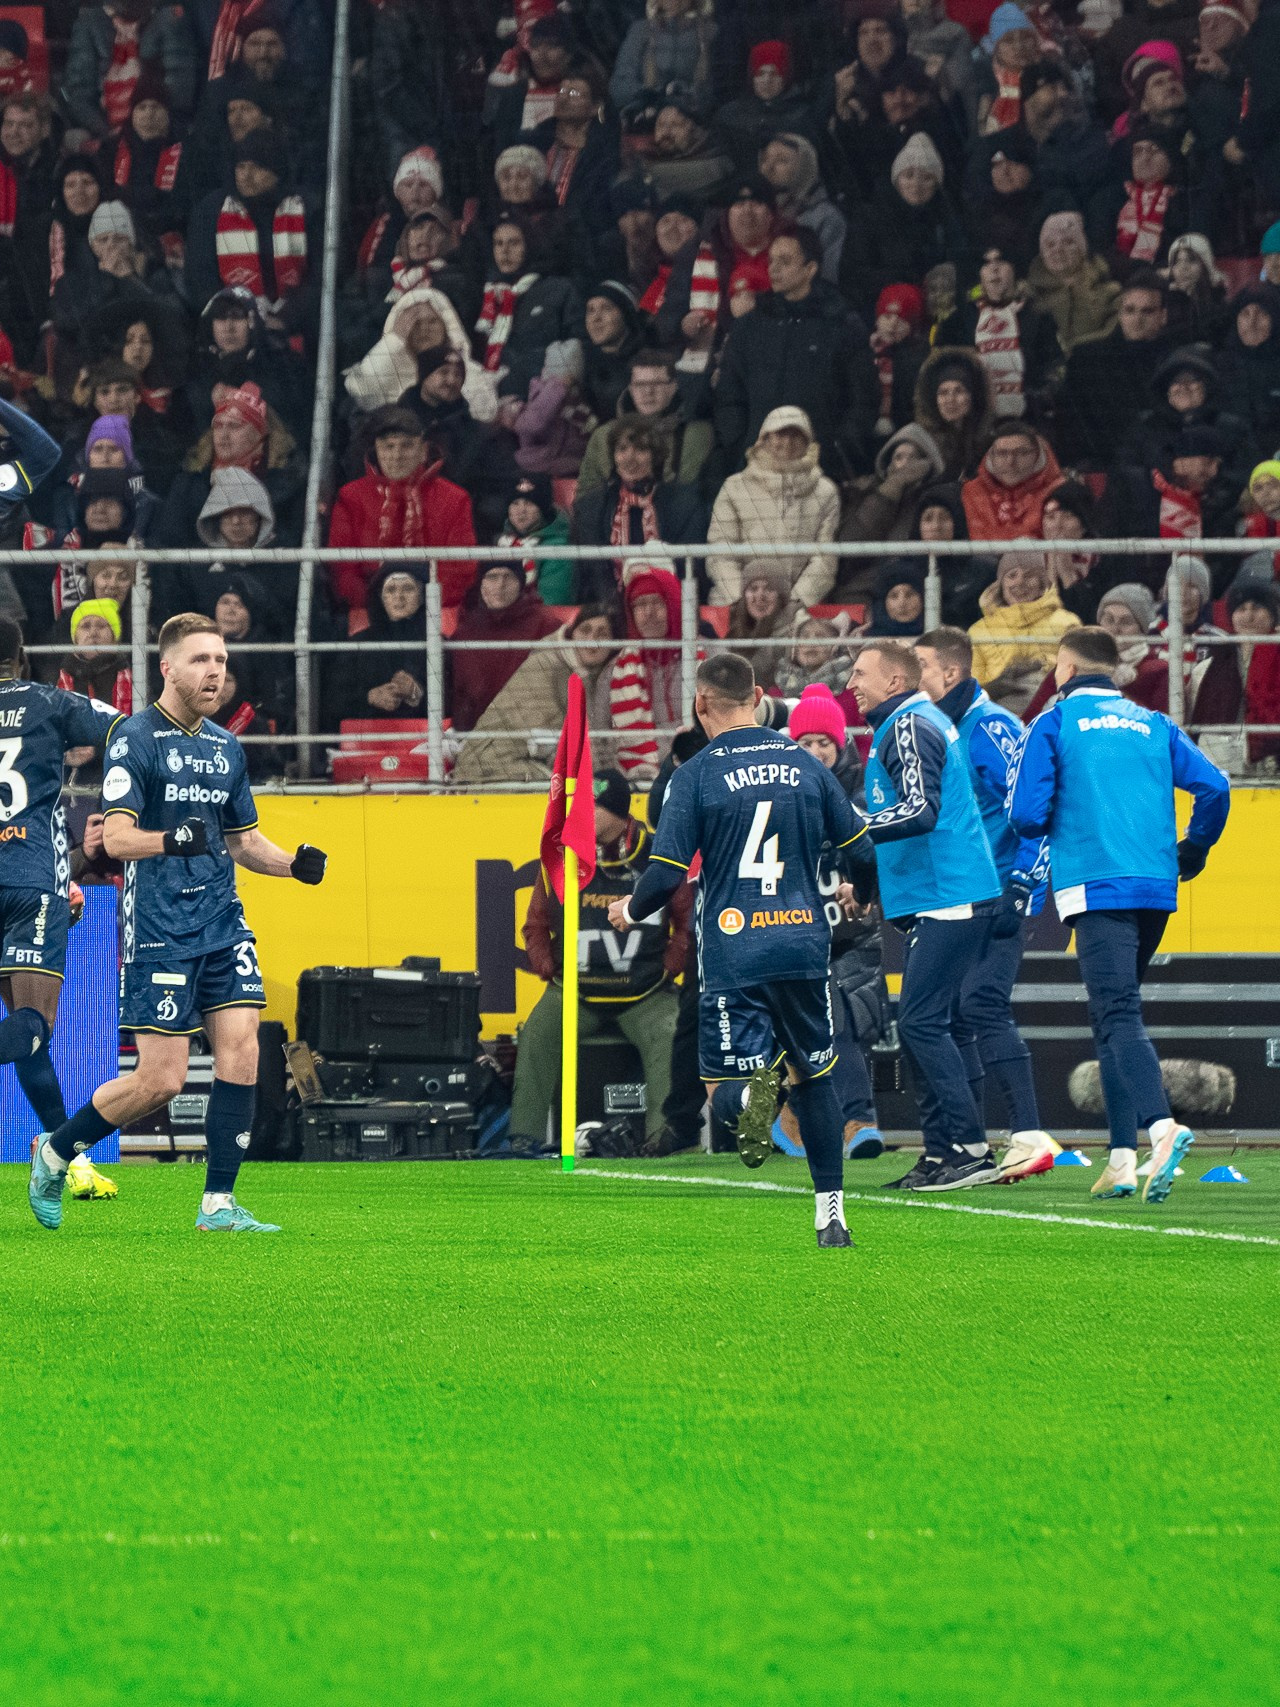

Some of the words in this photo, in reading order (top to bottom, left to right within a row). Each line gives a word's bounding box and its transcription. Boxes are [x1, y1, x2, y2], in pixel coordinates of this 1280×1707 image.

[1077, 714, 1152, 736] BetBoom
[723, 763, 801, 793] КАСЕРЕС
[738, 800, 785, 897] 4
[32, 893, 50, 946] BetBoom
[15, 949, 43, 965] ВТБ
[717, 995, 732, 1052] BetBom
[737, 1054, 766, 1071] ВТБ
